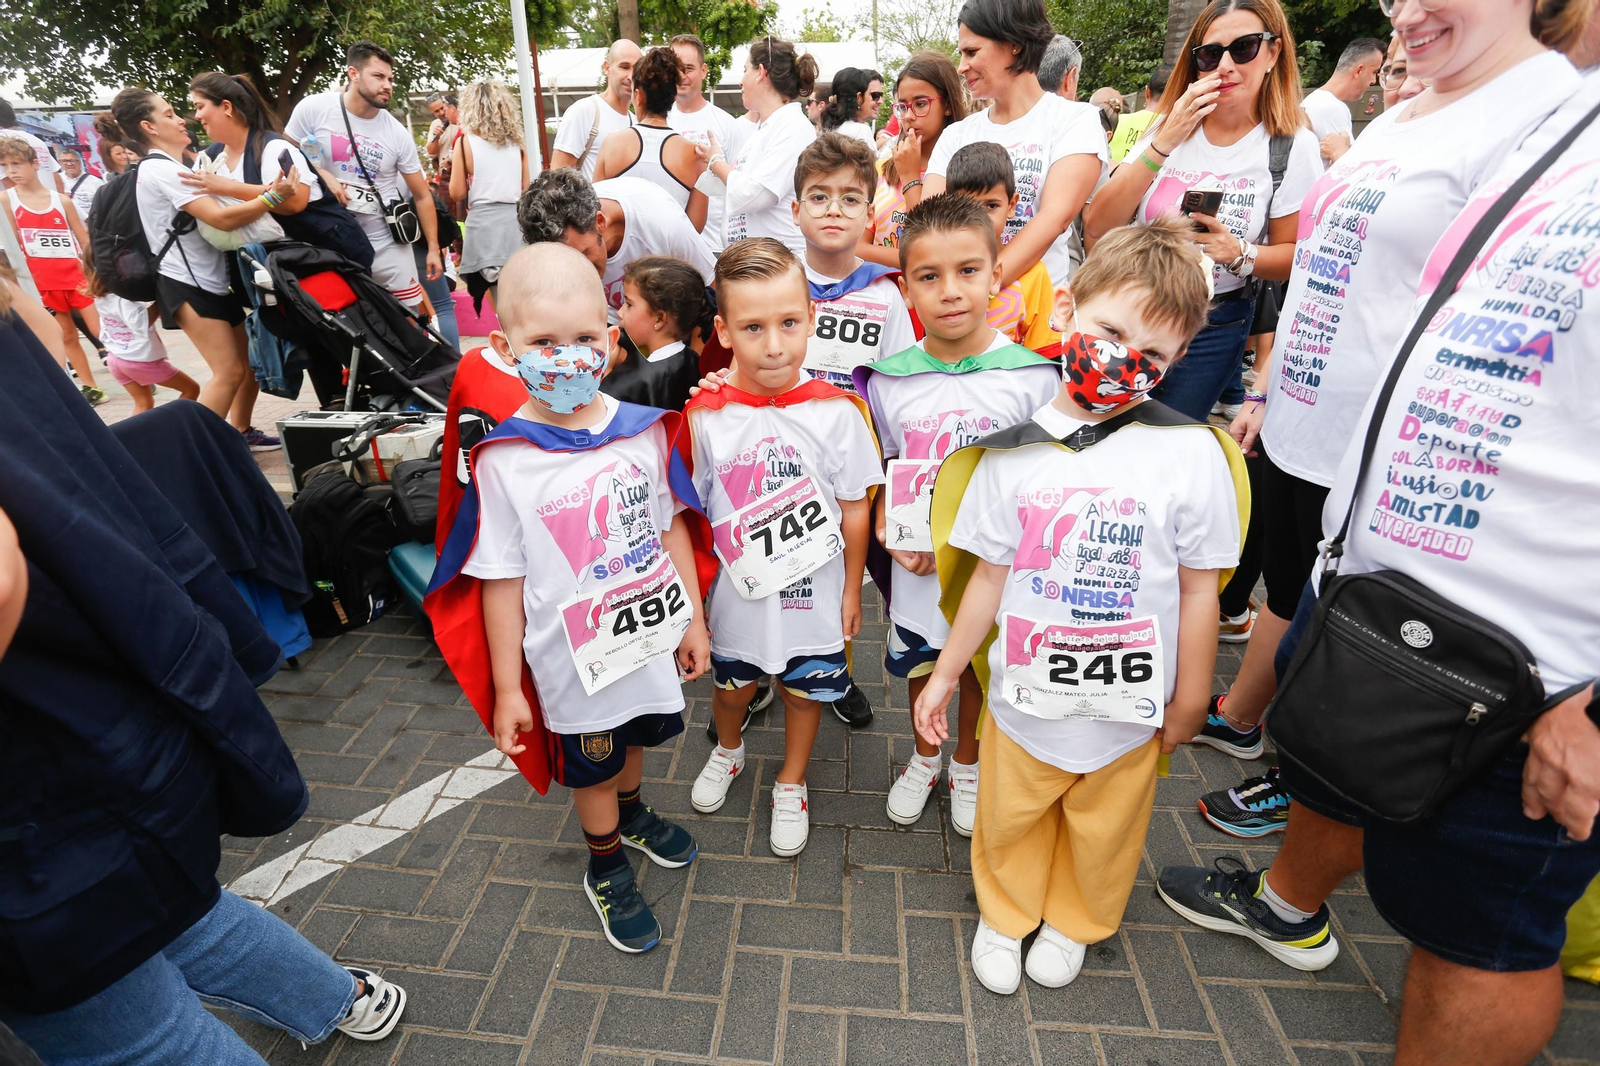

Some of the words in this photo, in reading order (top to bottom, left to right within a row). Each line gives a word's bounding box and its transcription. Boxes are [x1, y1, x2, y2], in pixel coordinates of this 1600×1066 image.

[40, 238, 71, 247] 265
[1295, 248, 1350, 284] SONRISA
[1495, 267, 1583, 309] FUERZA
[816, 315, 882, 347] 808
[1481, 298, 1577, 332] HUMILDAD
[1424, 306, 1554, 363] ONRISA
[956, 416, 999, 435] AMOR
[1398, 415, 1502, 463] Deporte
[767, 445, 802, 461] AMOR
[1391, 450, 1500, 476] COLABORAR
[536, 487, 589, 516] valores
[1086, 498, 1147, 520] AMOR
[750, 500, 828, 557] 742
[593, 538, 661, 580] SONRISA
[1076, 560, 1140, 580] FUERZA
[1031, 576, 1135, 609] SONRISA
[1074, 578, 1139, 592] HUMILDAD
[612, 583, 686, 637] 492
[605, 643, 628, 656] REBOLLO
[1120, 628, 1153, 643] valores
[1048, 652, 1153, 686] 246
